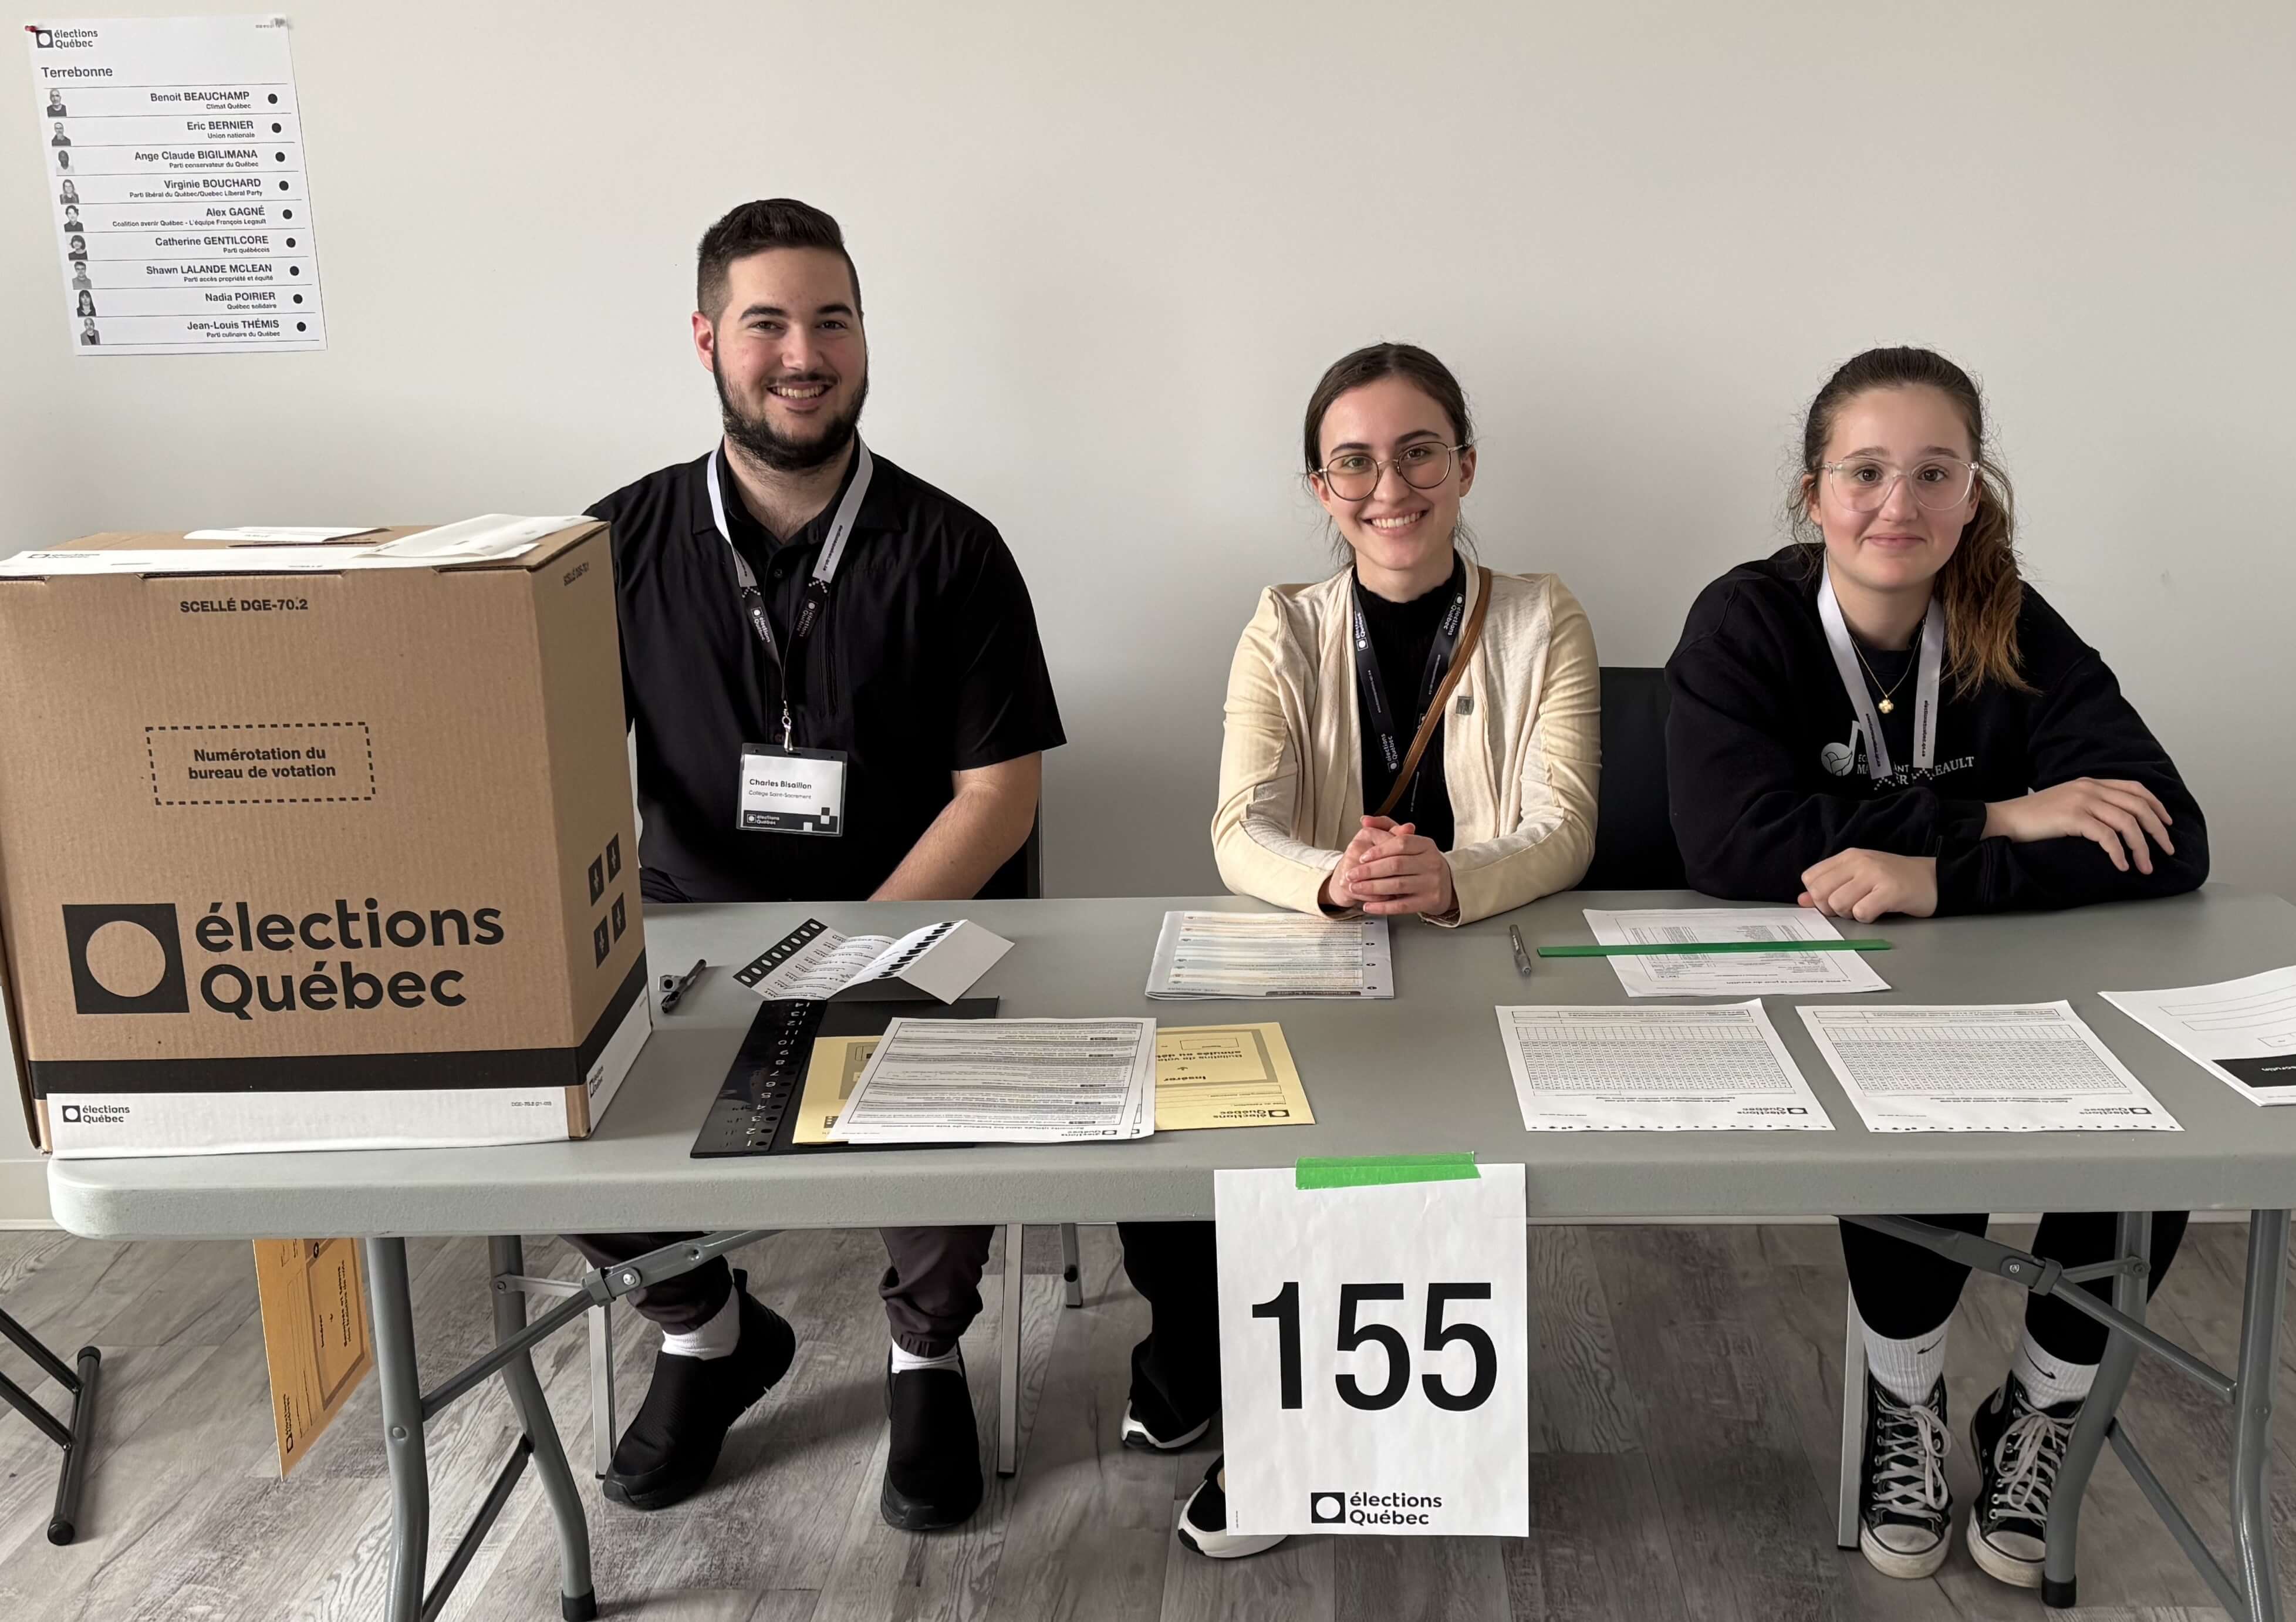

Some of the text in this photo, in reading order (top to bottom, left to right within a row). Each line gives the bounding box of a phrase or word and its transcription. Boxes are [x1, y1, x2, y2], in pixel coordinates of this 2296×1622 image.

[54, 29, 98, 38] élections
[55, 39, 93, 49] Québec
[41, 66, 113, 78] Terrebonne
[150, 92, 249, 102] Benoit BEAUCHAMP
[187, 120, 254, 130] Eric BERNIER
[135, 150, 258, 161] Ange Claude BIGILIMANA
[164, 178, 261, 190] Virginie BOUCHARD
[206, 205, 265, 217] Alex GAGNÉ
[155, 235, 269, 246] Catherine GENTILCORE
[146, 264, 272, 275] Shawn LALANDE MCLEAN
[205, 292, 276, 302] Nadia POIRIER
[187, 318, 279, 330] Jean-Louis THÉMIS
[180, 597, 308, 613] SCELLÉ DGE-70.2
[193, 747, 326, 762] Numérotation du
[1933, 756, 1974, 775] EAULT
[188, 765, 336, 779] bureau de votation
[749, 779, 812, 789] Charles Bisaillon
[195, 897, 504, 953] élections
[200, 960, 467, 1020] Québec
[82, 1104, 130, 1115] élections
[83, 1114, 124, 1124] Québec
[1252, 1281, 1497, 1411] 155
[1350, 1492, 1442, 1508] élections
[1350, 1508, 1429, 1526] Québec
